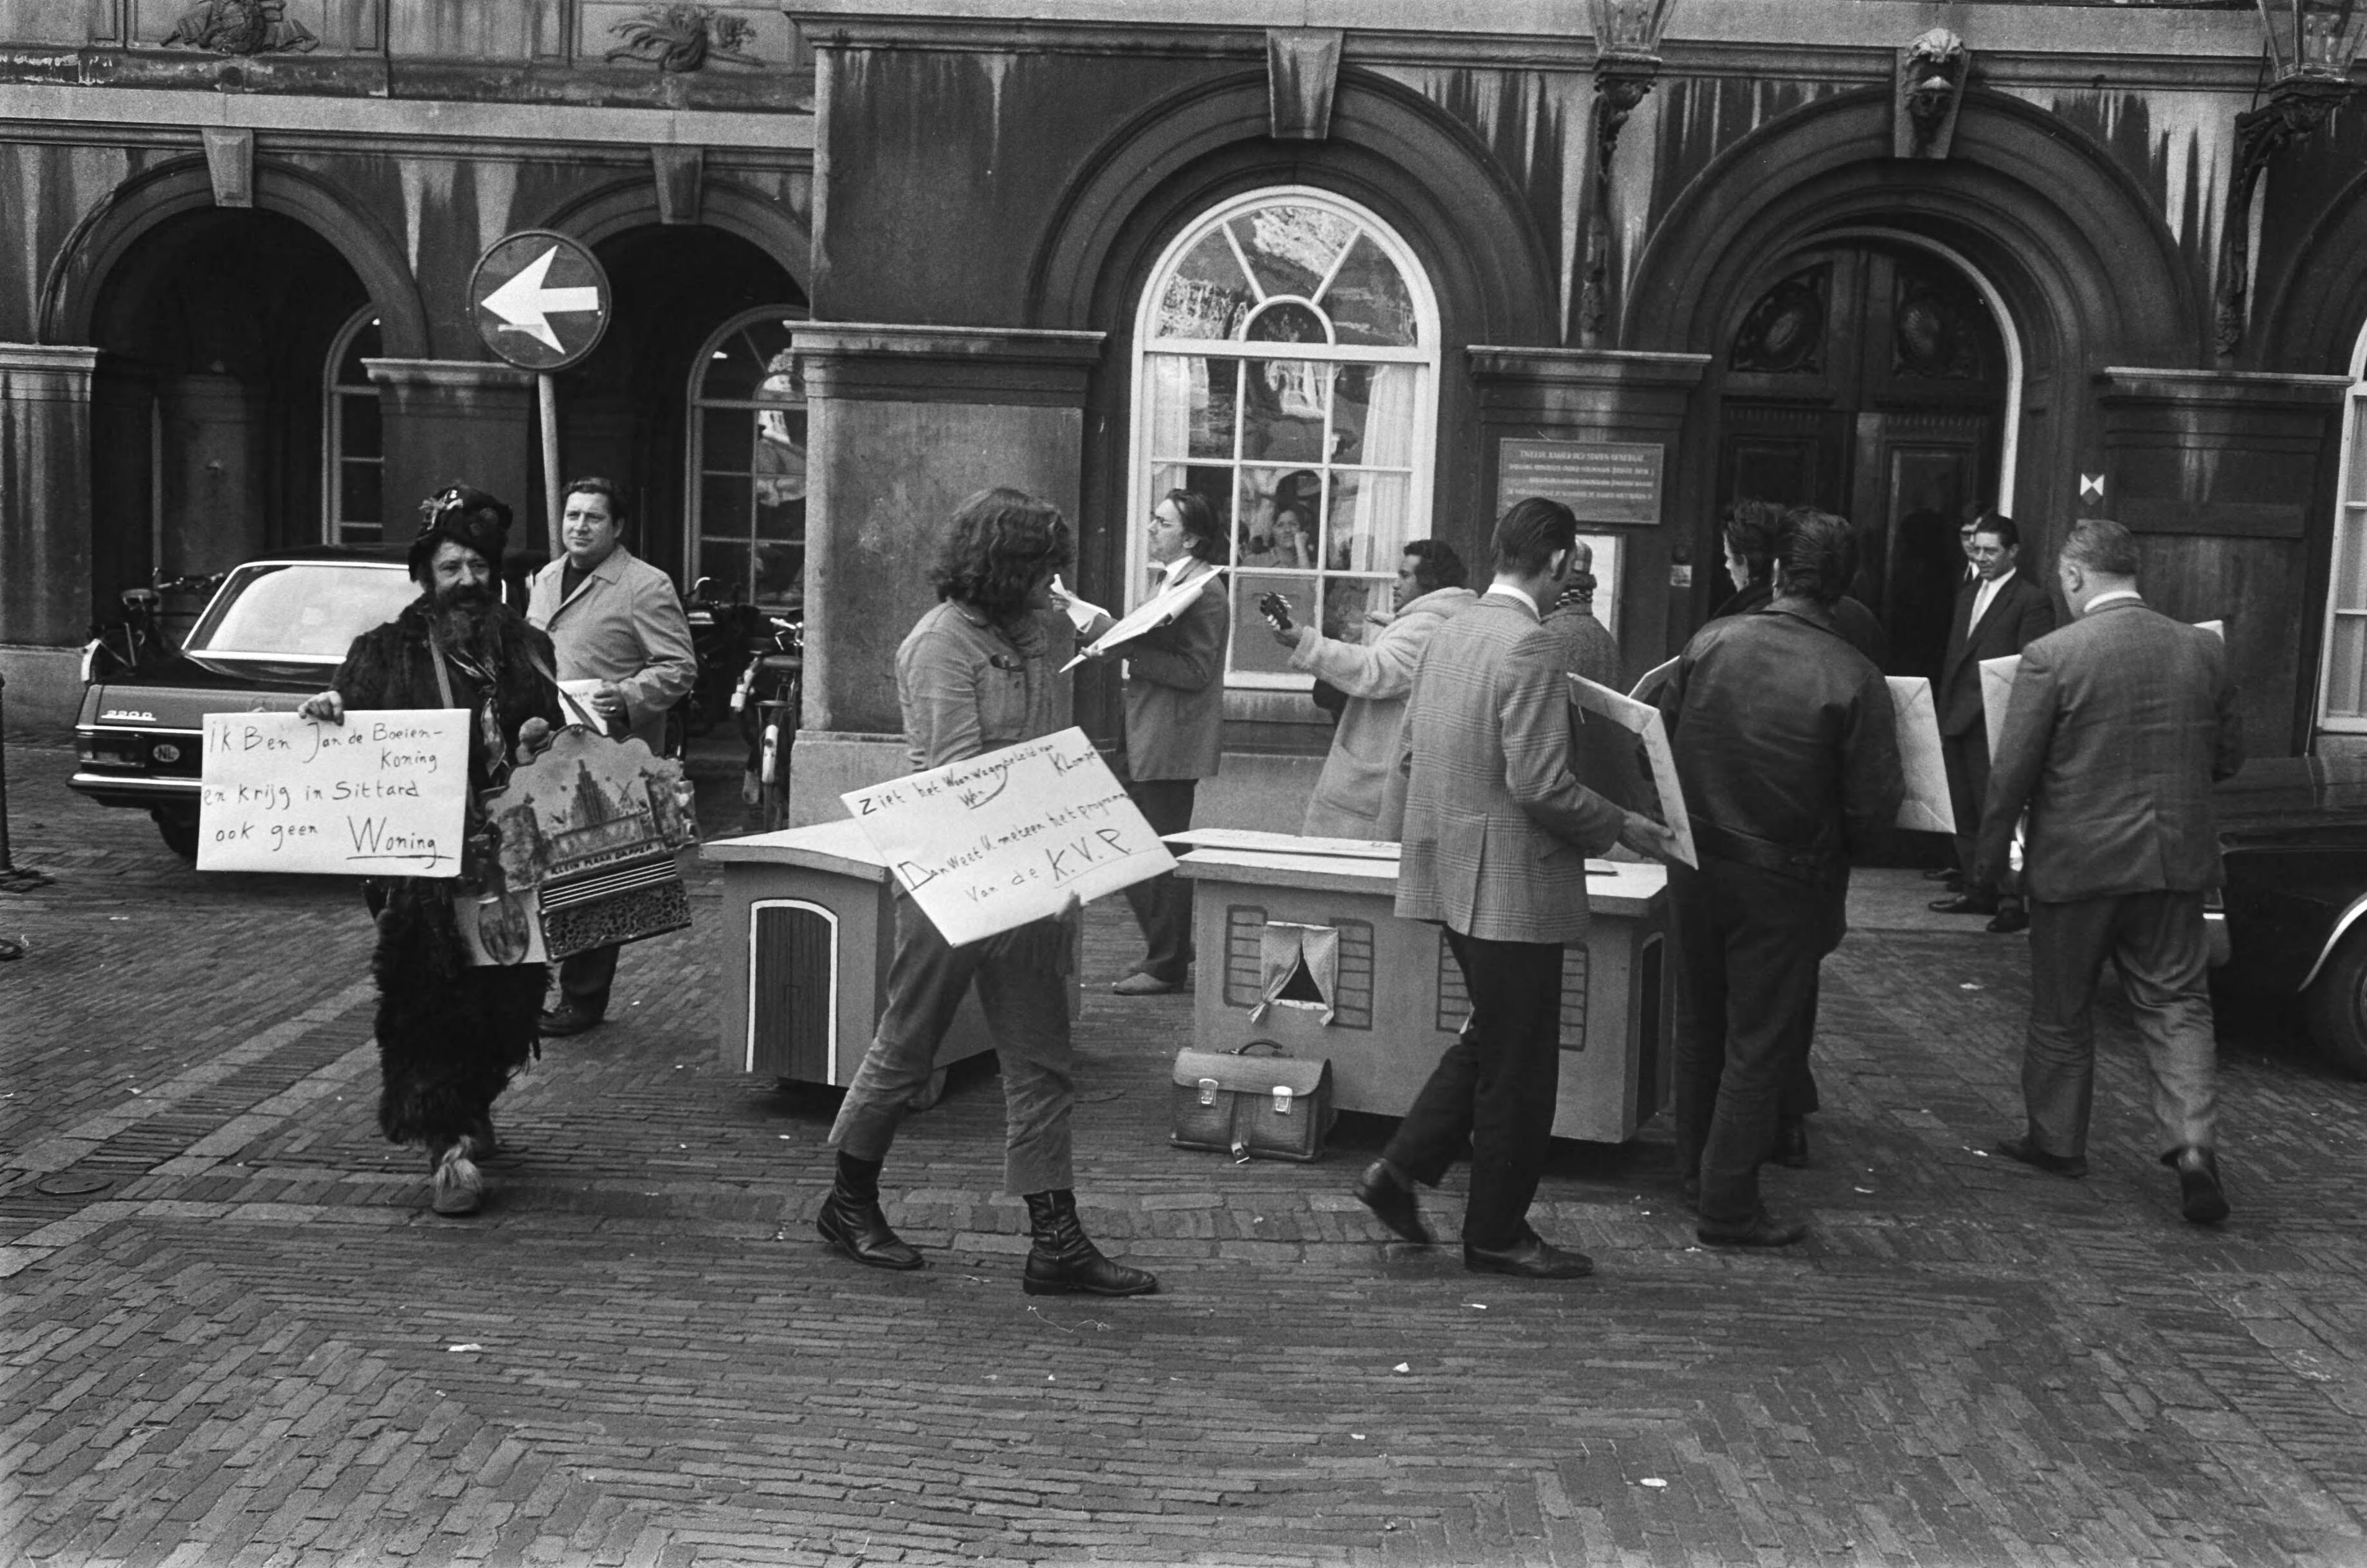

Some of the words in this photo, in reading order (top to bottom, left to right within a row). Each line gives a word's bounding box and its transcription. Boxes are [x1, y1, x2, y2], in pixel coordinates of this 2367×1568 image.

[158, 746, 175, 760] NL
[244, 725, 292, 751] Ben
[302, 721, 342, 764] Jan
[348, 727, 363, 744] de
[203, 789, 225, 805] en
[306, 785, 323, 801] in
[332, 779, 420, 800] Sittard
[859, 790, 906, 816] Ziet
[911, 781, 942, 798] het
[215, 824, 255, 842] ook
[271, 823, 318, 852] geen
[347, 816, 437, 869] Woning
[897, 860, 949, 891] Dan
[997, 824, 1045, 844] meteen
[1046, 807, 1077, 827] het
[1011, 868, 1039, 886] de
